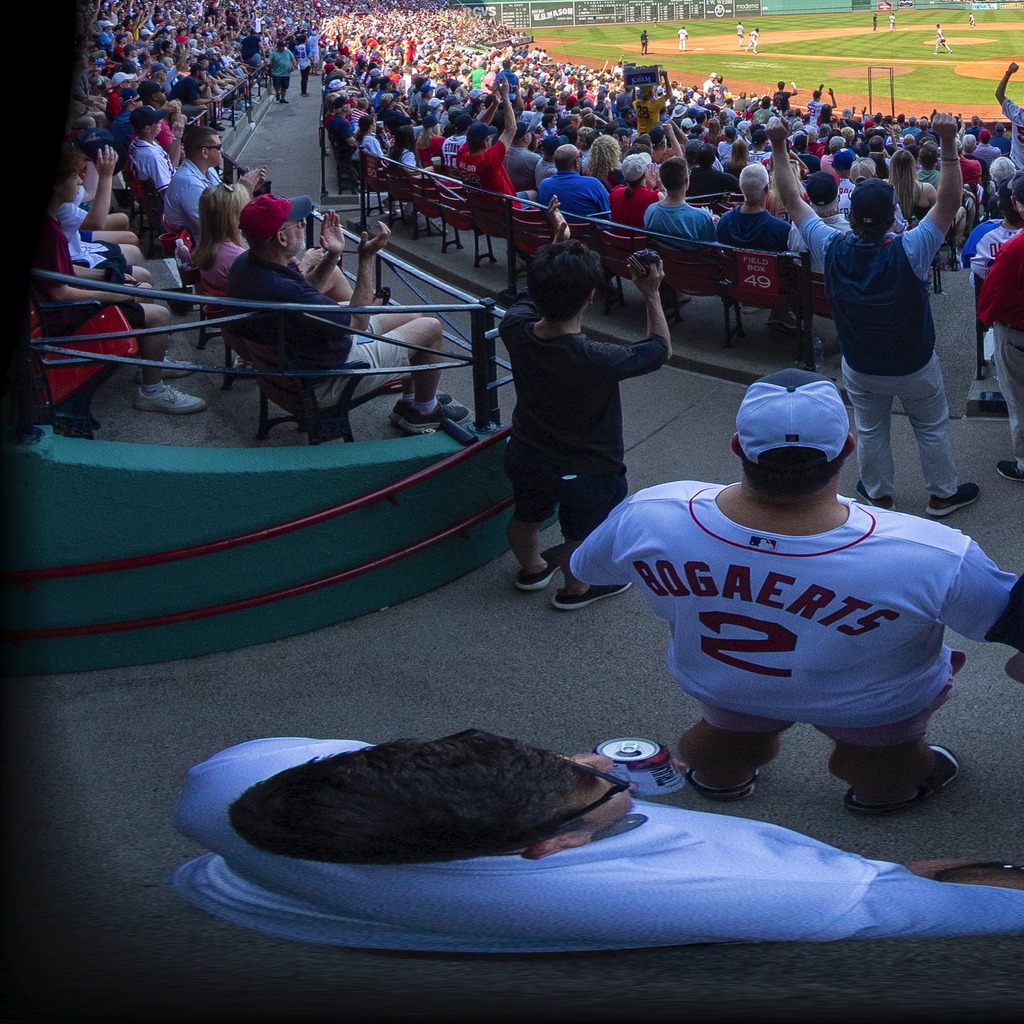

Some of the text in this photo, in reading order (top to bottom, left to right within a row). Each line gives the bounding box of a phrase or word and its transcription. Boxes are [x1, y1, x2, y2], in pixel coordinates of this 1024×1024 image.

[472, 6, 497, 17] CVS
[743, 256, 769, 265] FIELD
[747, 264, 766, 273] BOX
[743, 274, 772, 288] 49
[632, 560, 901, 636] BOGAERTS
[698, 610, 799, 678] 2
